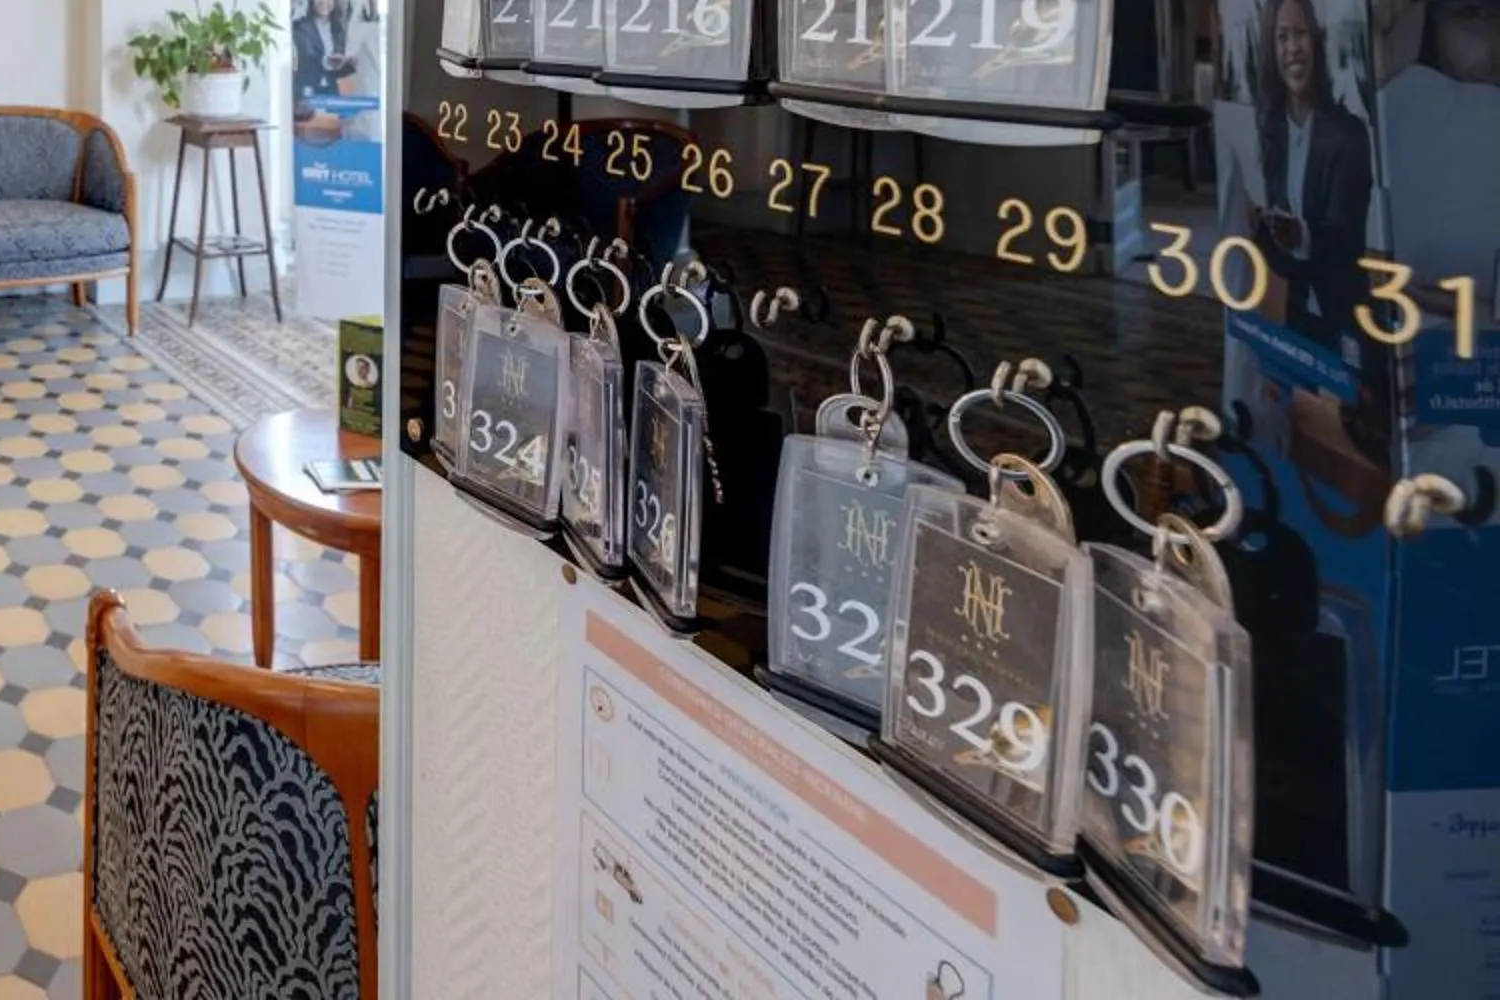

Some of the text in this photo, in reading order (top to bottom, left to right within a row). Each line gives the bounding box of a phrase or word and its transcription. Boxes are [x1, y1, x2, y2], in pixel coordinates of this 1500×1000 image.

[437, 100, 468, 142] 22
[486, 109, 522, 153] 23
[541, 119, 583, 166] 24
[606, 130, 653, 180] 25
[681, 143, 734, 198] 26
[767, 157, 831, 217] 27
[871, 175, 945, 244] 28
[997, 198, 1087, 272] 29
[1147, 221, 1268, 312] 30
[1353, 256, 1475, 359] 31
[470, 409, 546, 484] 324
[790, 582, 884, 665] 32
[906, 650, 1047, 771] 329
[1087, 723, 1199, 875] 330
